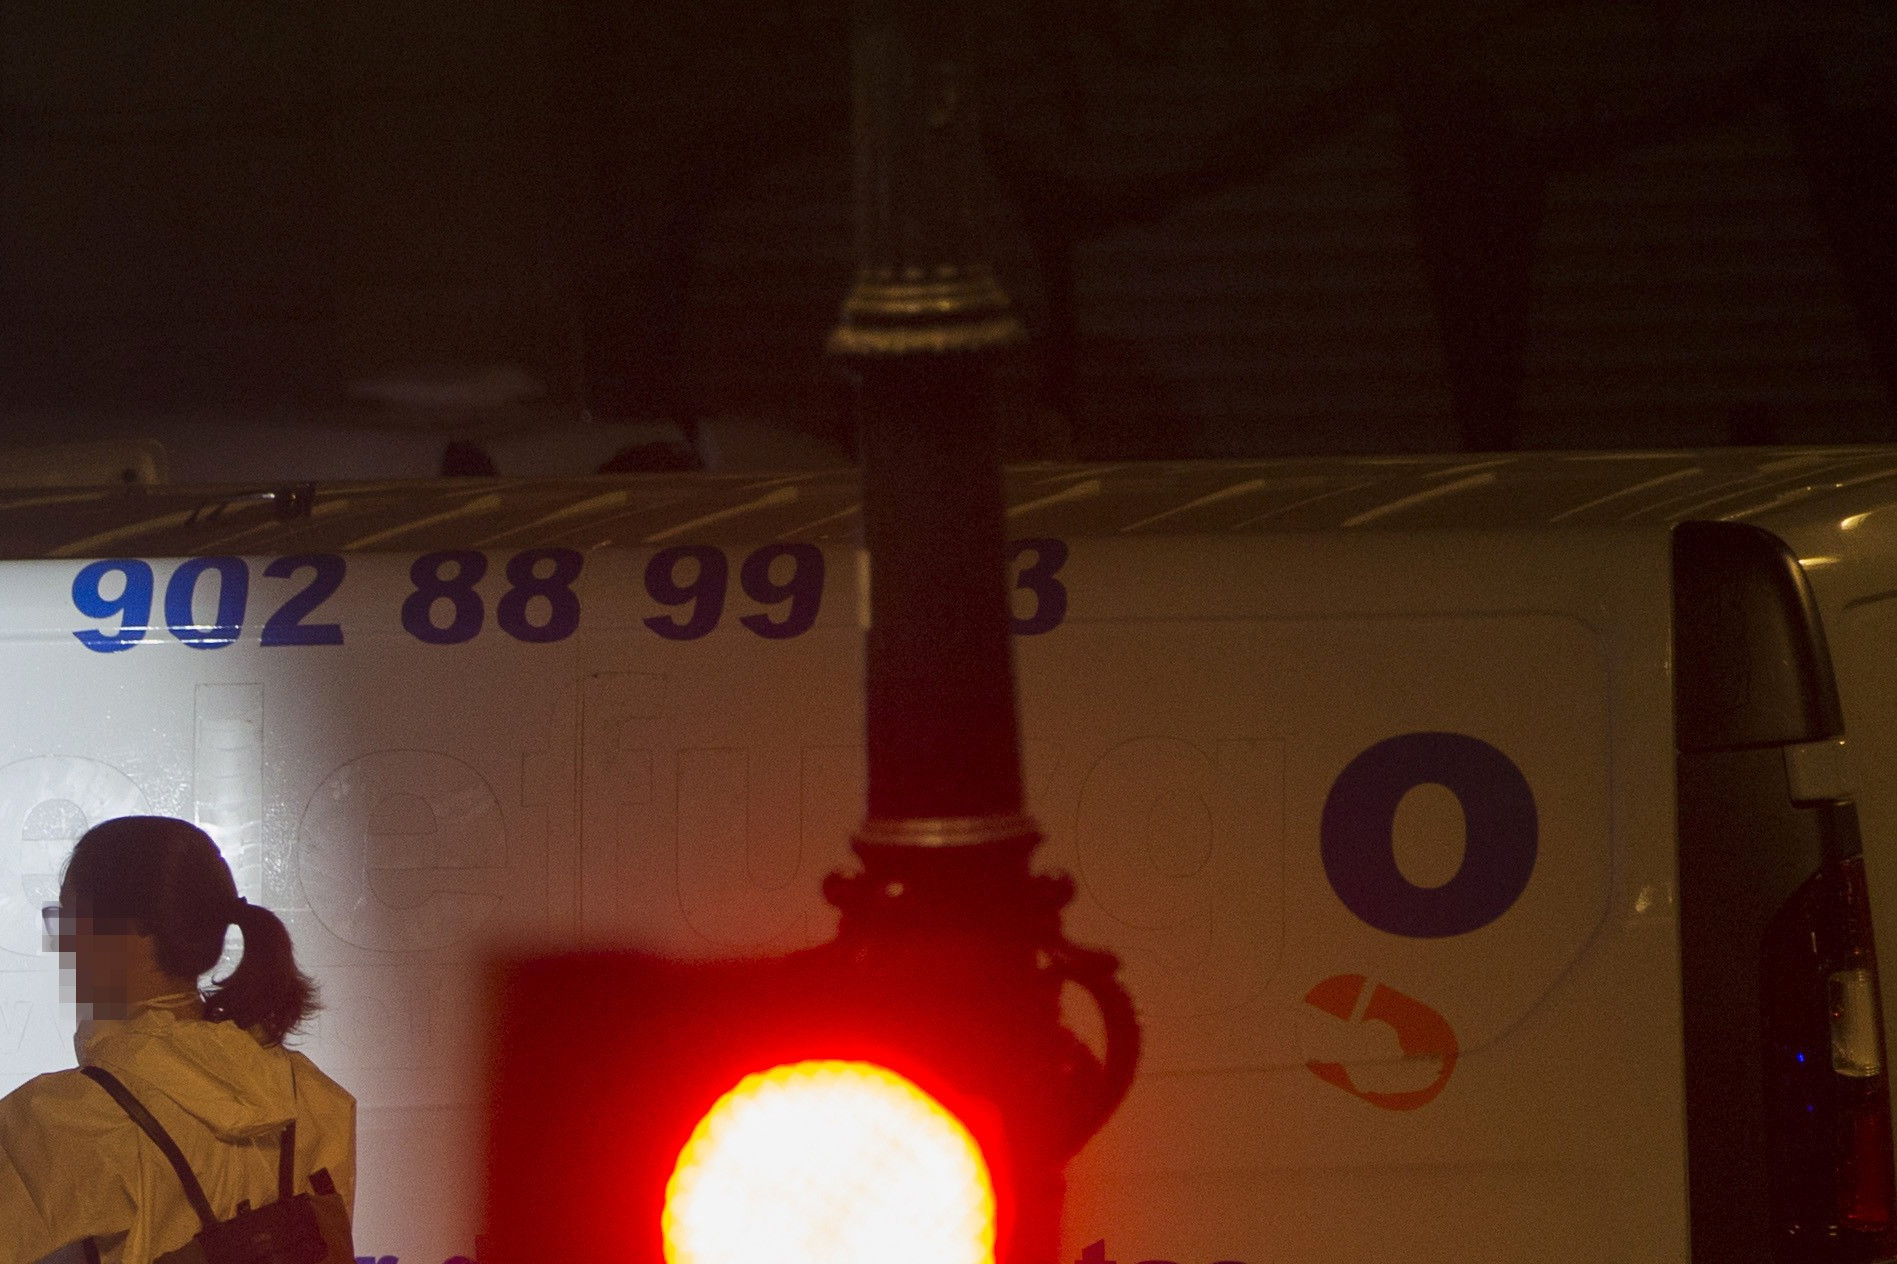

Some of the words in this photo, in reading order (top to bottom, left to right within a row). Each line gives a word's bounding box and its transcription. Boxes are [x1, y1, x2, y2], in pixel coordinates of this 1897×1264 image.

[71, 554, 347, 653] 902
[401, 548, 585, 645] 88
[642, 543, 826, 641] 99
